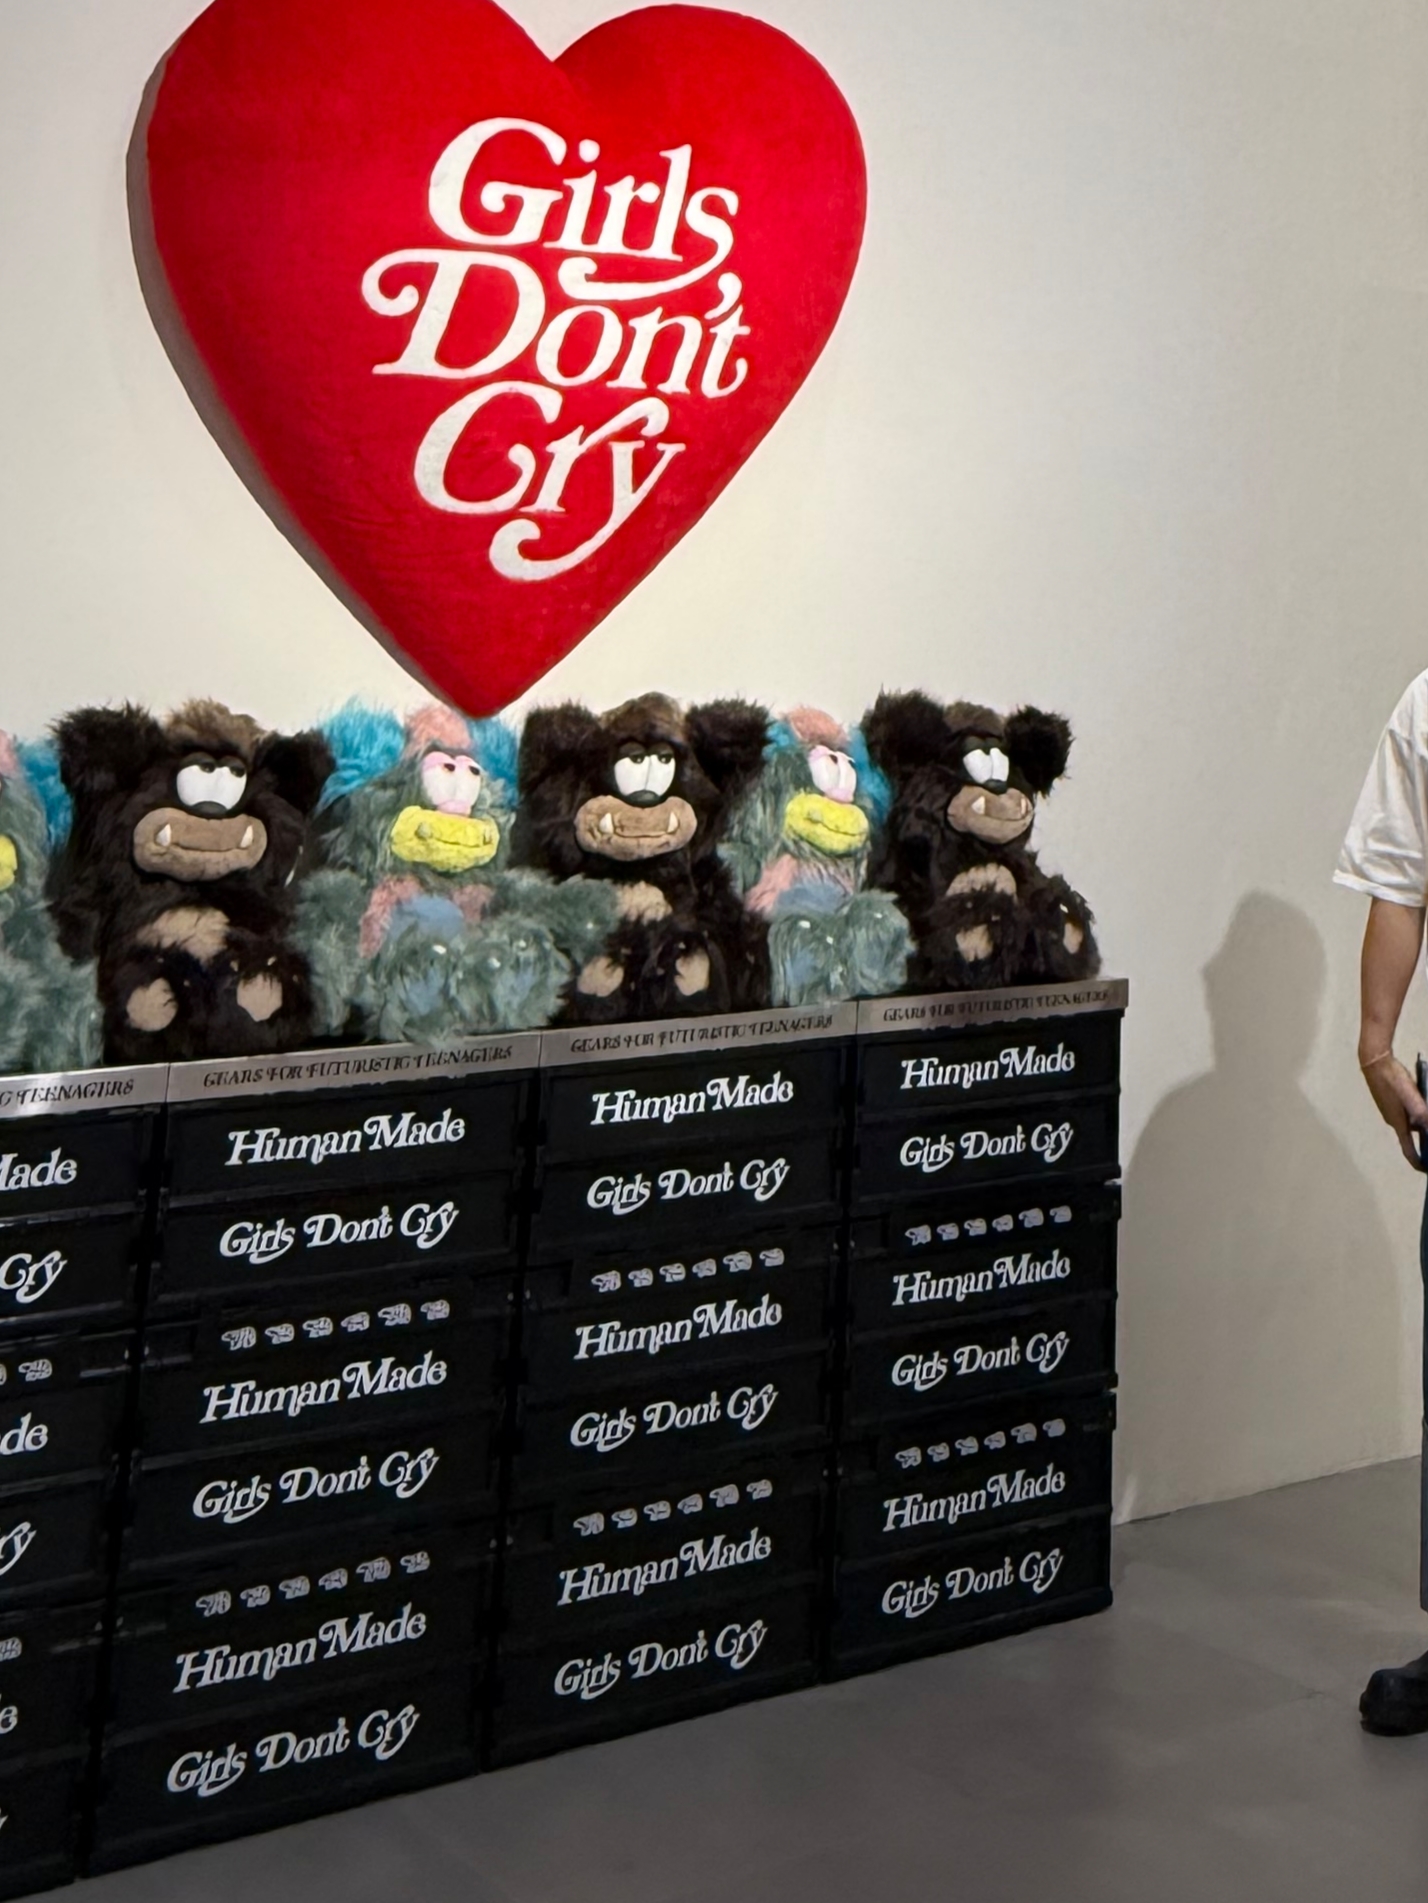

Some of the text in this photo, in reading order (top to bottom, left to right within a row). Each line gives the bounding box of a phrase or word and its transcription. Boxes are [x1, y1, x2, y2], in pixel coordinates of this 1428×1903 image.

[429, 117, 739, 300] Girls
[362, 248, 751, 399] Don't
[414, 380, 686, 581] Cry
[590, 1071, 794, 1127] Human Made
[225, 1108, 466, 1166] Human Made
[900, 1132, 955, 1173] Girls
[1030, 1122, 1074, 1163] Cry
[586, 1174, 651, 1215] Girls
[740, 1158, 791, 1202] Cry
[219, 1220, 296, 1264] Girls
[401, 1201, 459, 1249] Cry
[0, 1250, 68, 1304] Cry
[573, 1294, 782, 1360] Human Made
[891, 1350, 949, 1392] Girls
[1025, 1331, 1070, 1373] Cry
[200, 1351, 447, 1424] Human Made
[570, 1408, 637, 1452] Girls
[727, 1383, 779, 1431] Cry
[0, 1412, 48, 1456] de
[193, 1475, 272, 1524] Girls
[379, 1447, 440, 1498] Cry
[557, 1527, 772, 1606] Human Made
[881, 1577, 941, 1618] Girls
[1019, 1548, 1064, 1594] Cry
[173, 1603, 427, 1694] Human Made
[554, 1652, 622, 1700] Girls
[714, 1620, 768, 1670] Cry
[167, 1744, 247, 1797] Girls
[357, 1704, 421, 1761] Cry
